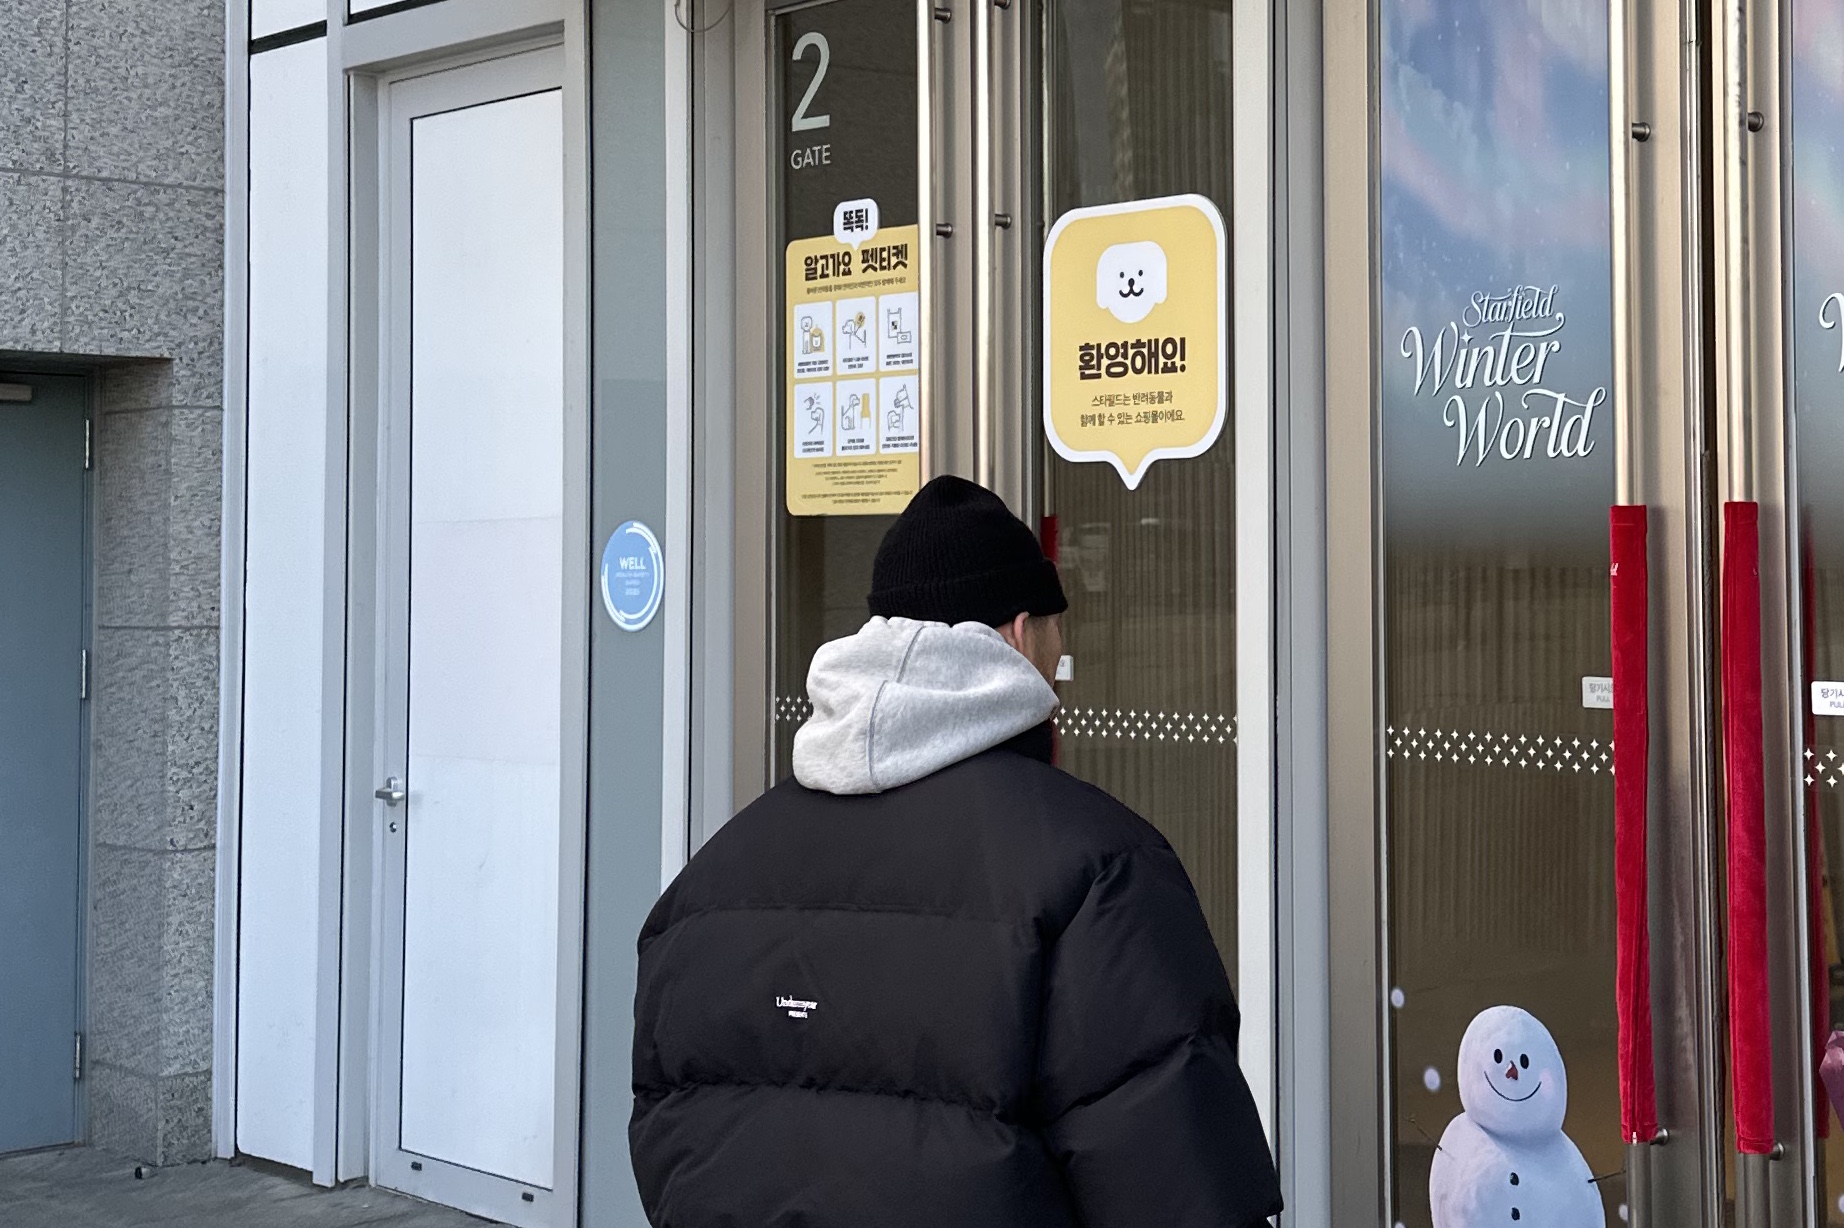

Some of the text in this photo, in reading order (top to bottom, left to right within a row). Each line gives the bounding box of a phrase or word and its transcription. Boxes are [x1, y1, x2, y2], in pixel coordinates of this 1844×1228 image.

[791, 31, 831, 132] 2
[790, 144, 832, 170] GATE
[842, 208, 869, 233] 똑똑!
[804, 243, 909, 282] 알고가요 펫티켓
[1462, 284, 1560, 329] Starfield
[1078, 336, 1187, 381] 환영해요!
[1400, 312, 1566, 397] Winter
[1091, 390, 1174, 407] 스타필드는 반려동물과
[1107, 412, 1116, 426] 수
[1443, 386, 1608, 468] World
[619, 556, 647, 570] WELL
